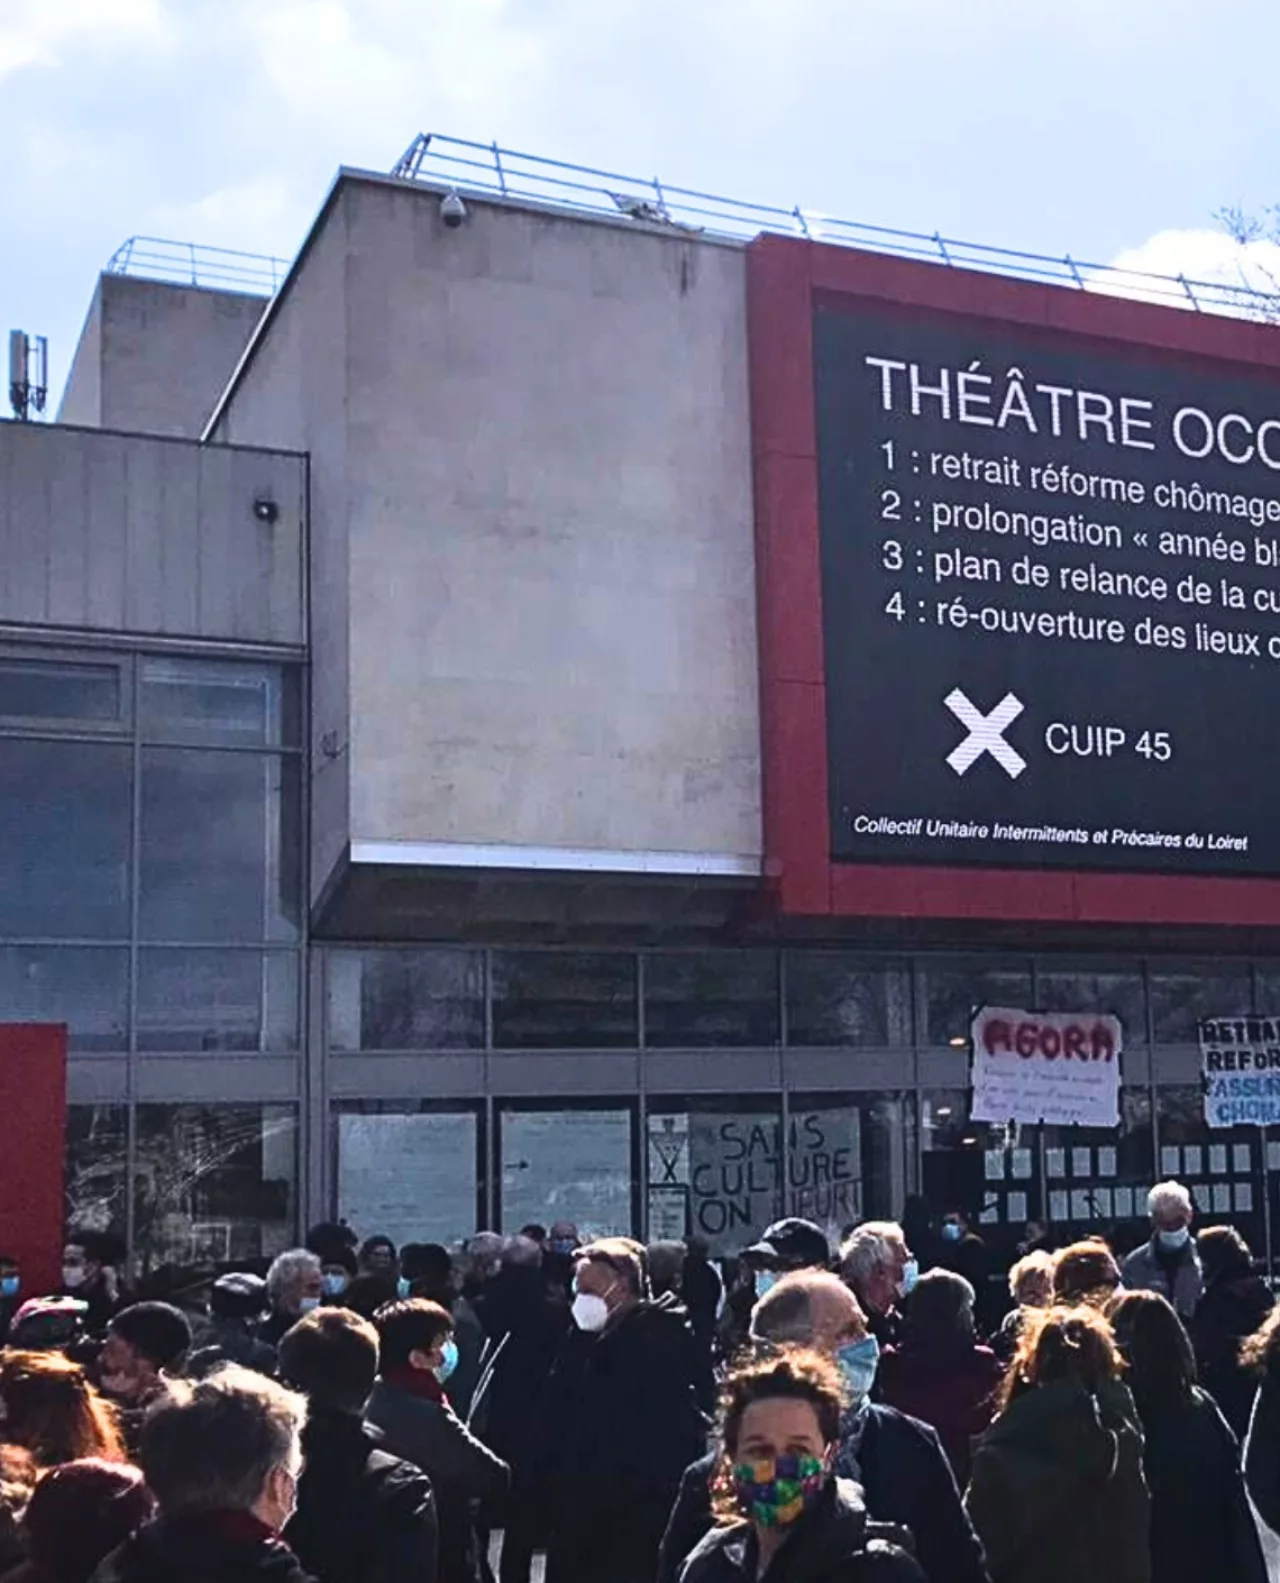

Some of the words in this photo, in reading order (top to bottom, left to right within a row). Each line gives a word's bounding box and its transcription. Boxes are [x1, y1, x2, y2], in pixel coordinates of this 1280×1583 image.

[865, 356, 1156, 451] THÉÂTRE
[881, 440, 894, 470] 1
[931, 452, 1021, 487] retrait
[1030, 462, 1146, 504] réforme
[881, 489, 902, 520] 2
[932, 502, 1122, 548] prolongation
[1158, 529, 1246, 562] année
[882, 540, 904, 570] 3
[934, 552, 1001, 583] plan
[1011, 555, 1050, 588] de
[1059, 562, 1168, 601] relance
[1176, 574, 1212, 605] de
[1220, 578, 1246, 609] la
[885, 591, 906, 621] 4
[936, 600, 1126, 643] ré-ouverture
[1134, 617, 1187, 649] des
[1195, 622, 1261, 657] lieux
[1045, 723, 1126, 757] CUIP
[1134, 730, 1171, 761] 45
[854, 814, 922, 836] Collectif
[927, 818, 988, 839] Unitaire
[993, 822, 1089, 844] Intermittents
[1092, 829, 1109, 845] et
[1111, 828, 1182, 849] Précaires
[1185, 833, 1205, 849] du
[1207, 832, 1249, 851] Loiret
[982, 1018, 1115, 1063] AGORA
[720, 1115, 825, 1161] SANS
[692, 1148, 852, 1198] CULTURE
[698, 1197, 752, 1235] ON
